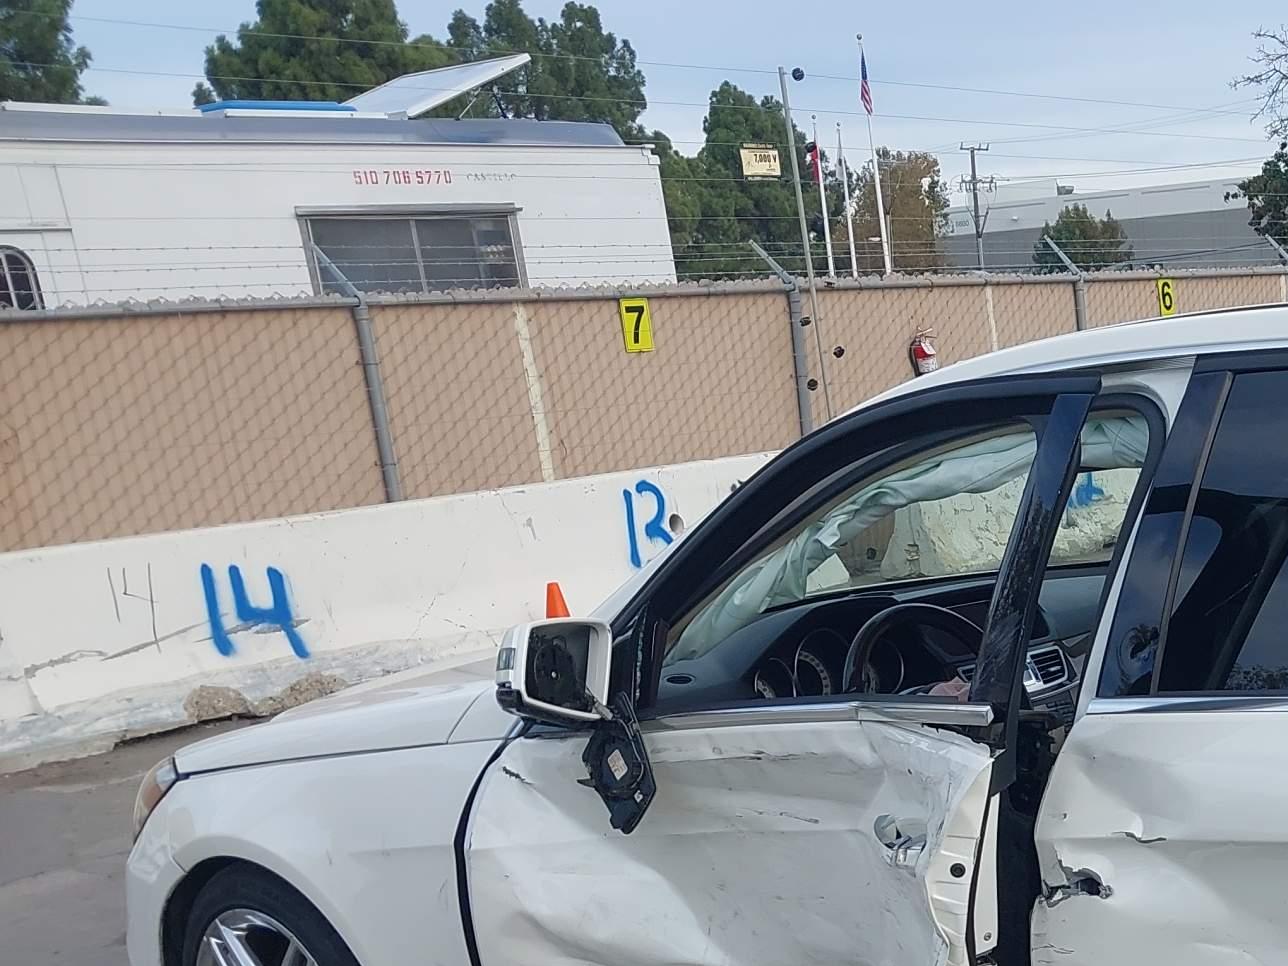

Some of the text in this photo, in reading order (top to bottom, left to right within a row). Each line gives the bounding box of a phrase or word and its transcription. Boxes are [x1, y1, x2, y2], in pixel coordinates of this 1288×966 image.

[353, 171, 378, 184] 510
[383, 171, 410, 184] 706
[415, 171, 452, 184] 5770
[1162, 281, 1173, 311] 6
[625, 305, 645, 344] 7
[201, 564, 310, 658] 14
